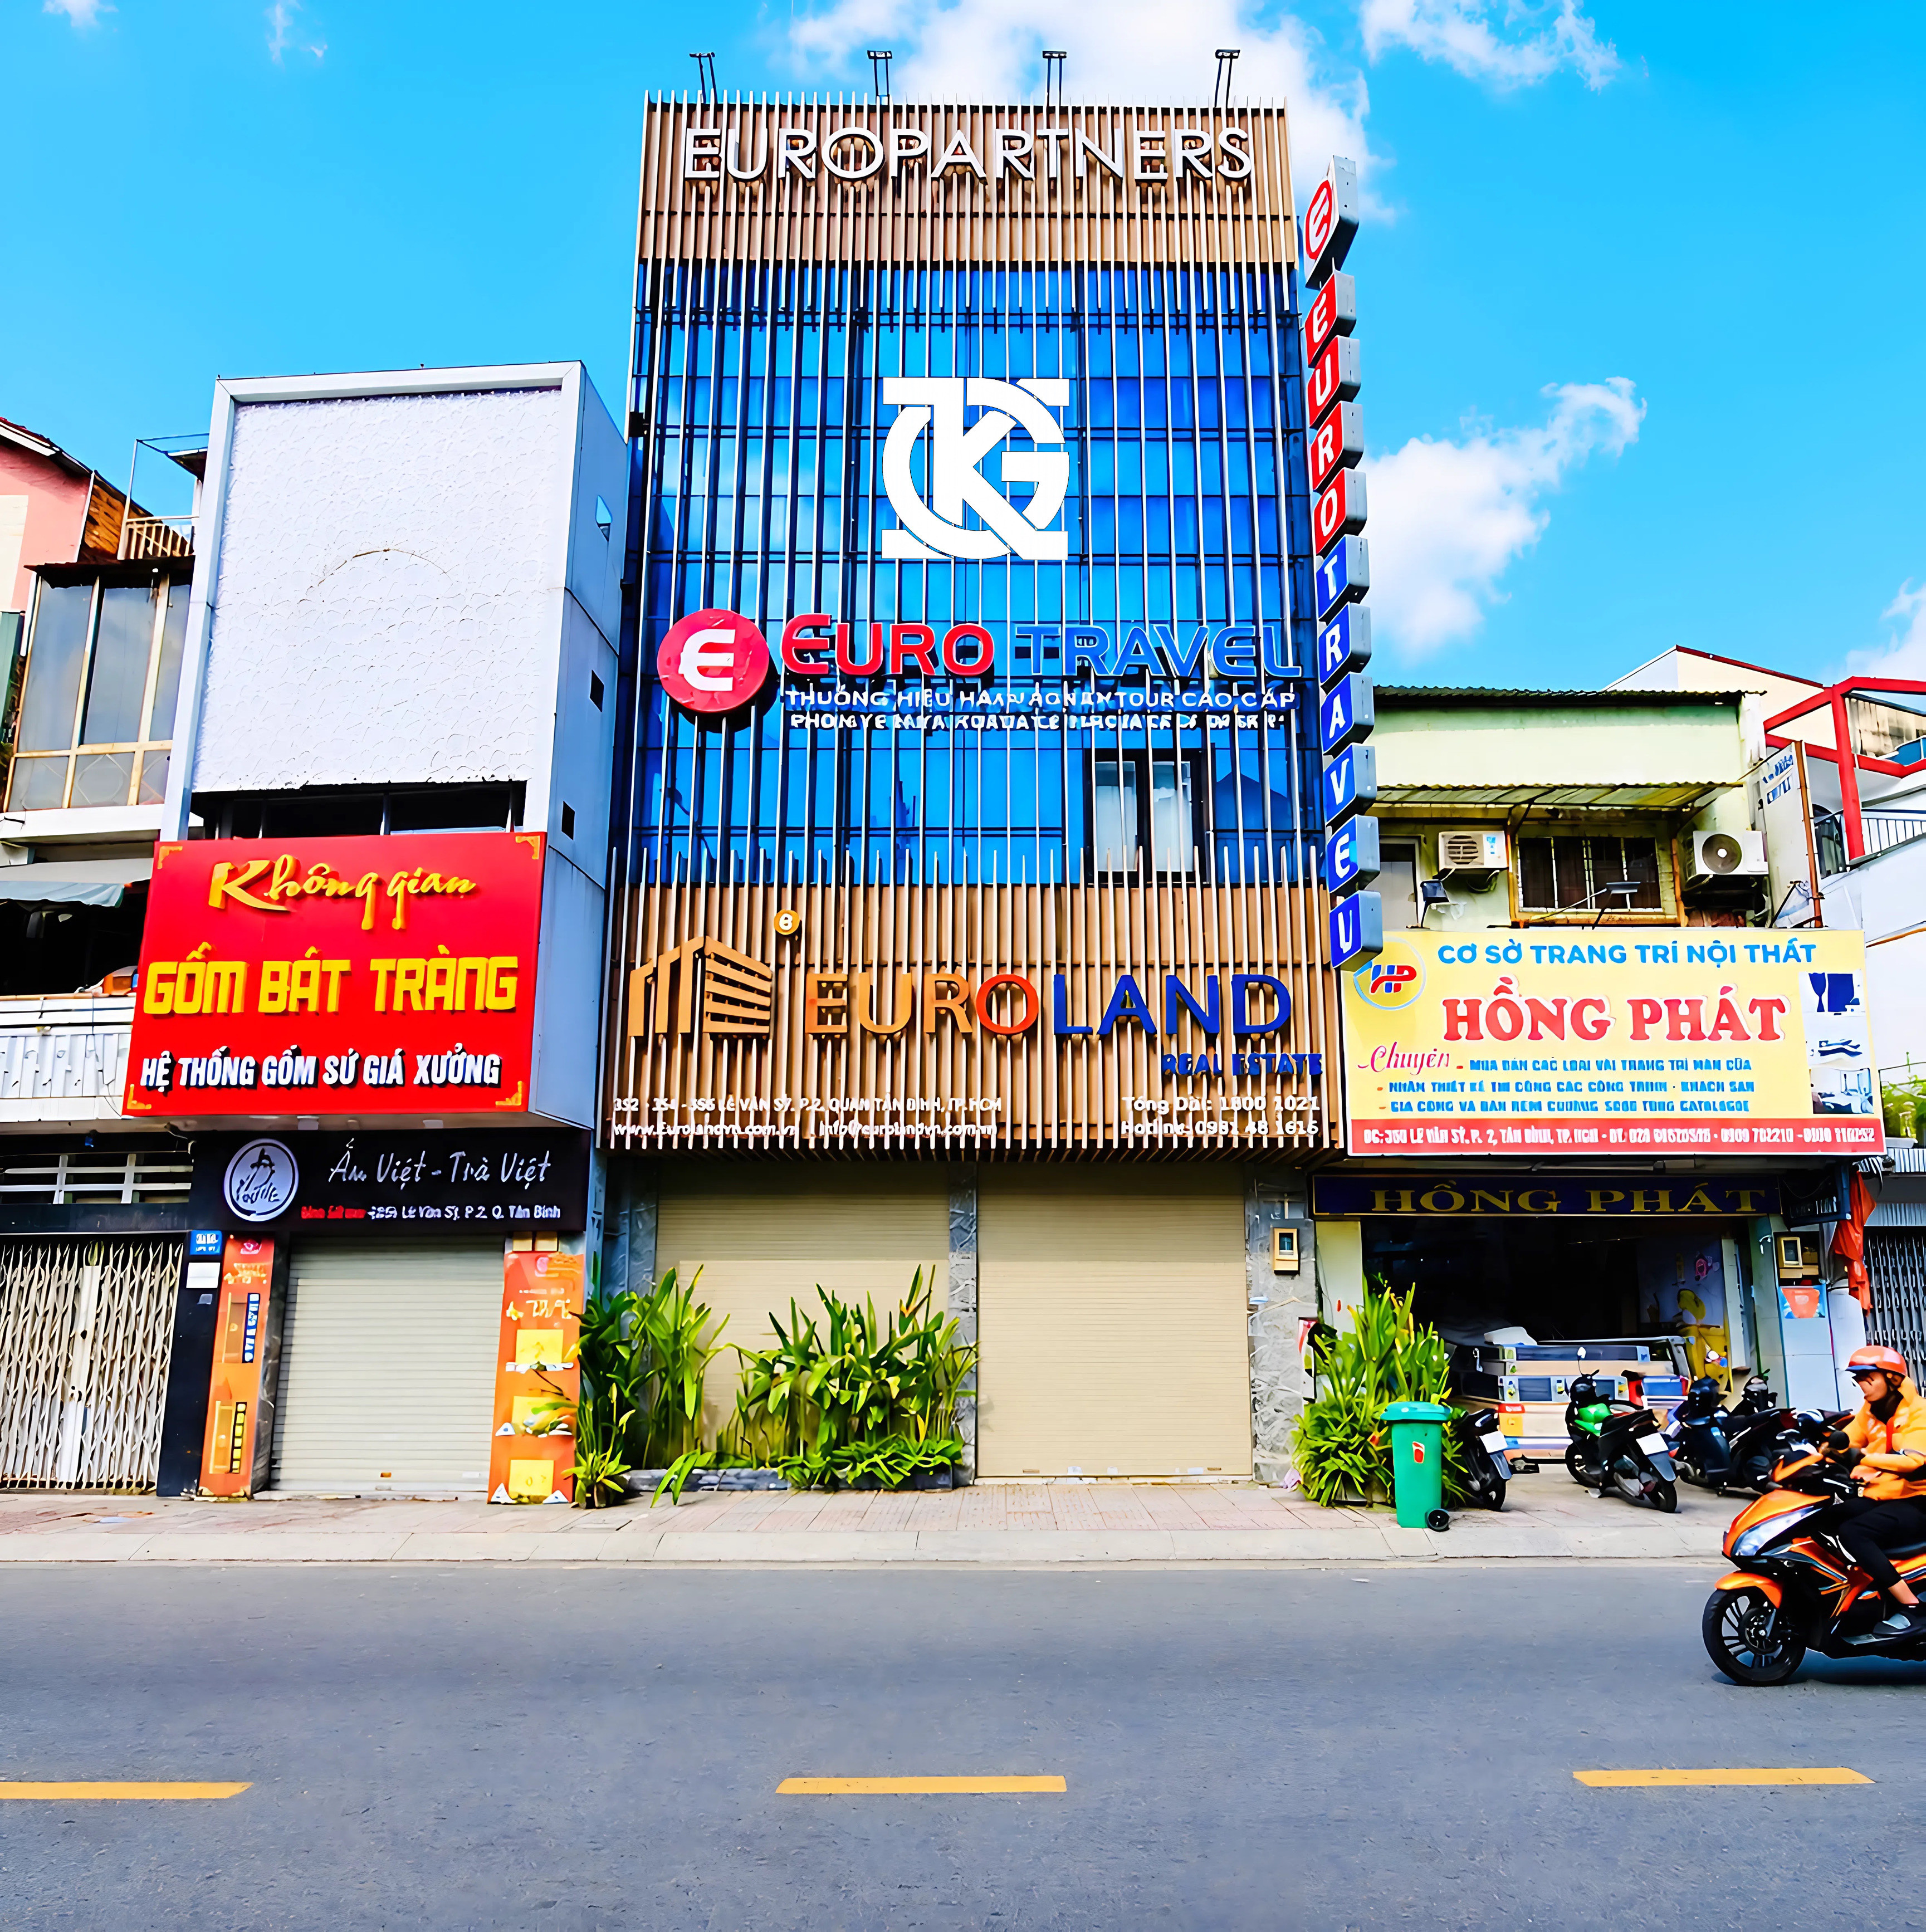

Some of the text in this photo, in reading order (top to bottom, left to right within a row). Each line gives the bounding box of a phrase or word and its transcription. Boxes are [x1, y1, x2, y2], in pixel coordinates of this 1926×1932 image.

[685, 127, 1252, 181] EUROPARTNERS
[781, 614, 1303, 677] EURO TRAVEL
[208, 854, 477, 930] Không gian
[143, 941, 249, 1015] GỐM
[369, 945, 519, 1013] TRÀNG
[1438, 943, 1477, 964] CƠ
[1530, 945, 1626, 964] TRANG
[1687, 940, 1736, 968] NỘI
[805, 972, 1293, 1035] EUROLAND
[1442, 976, 1786, 1041] HỒNG PHÁT
[140, 1042, 501, 1092] HỆ THỐNG GỐM SỨ GIÁ XƯỞNG
[1161, 1053, 1323, 1075] REAL ESTATE
